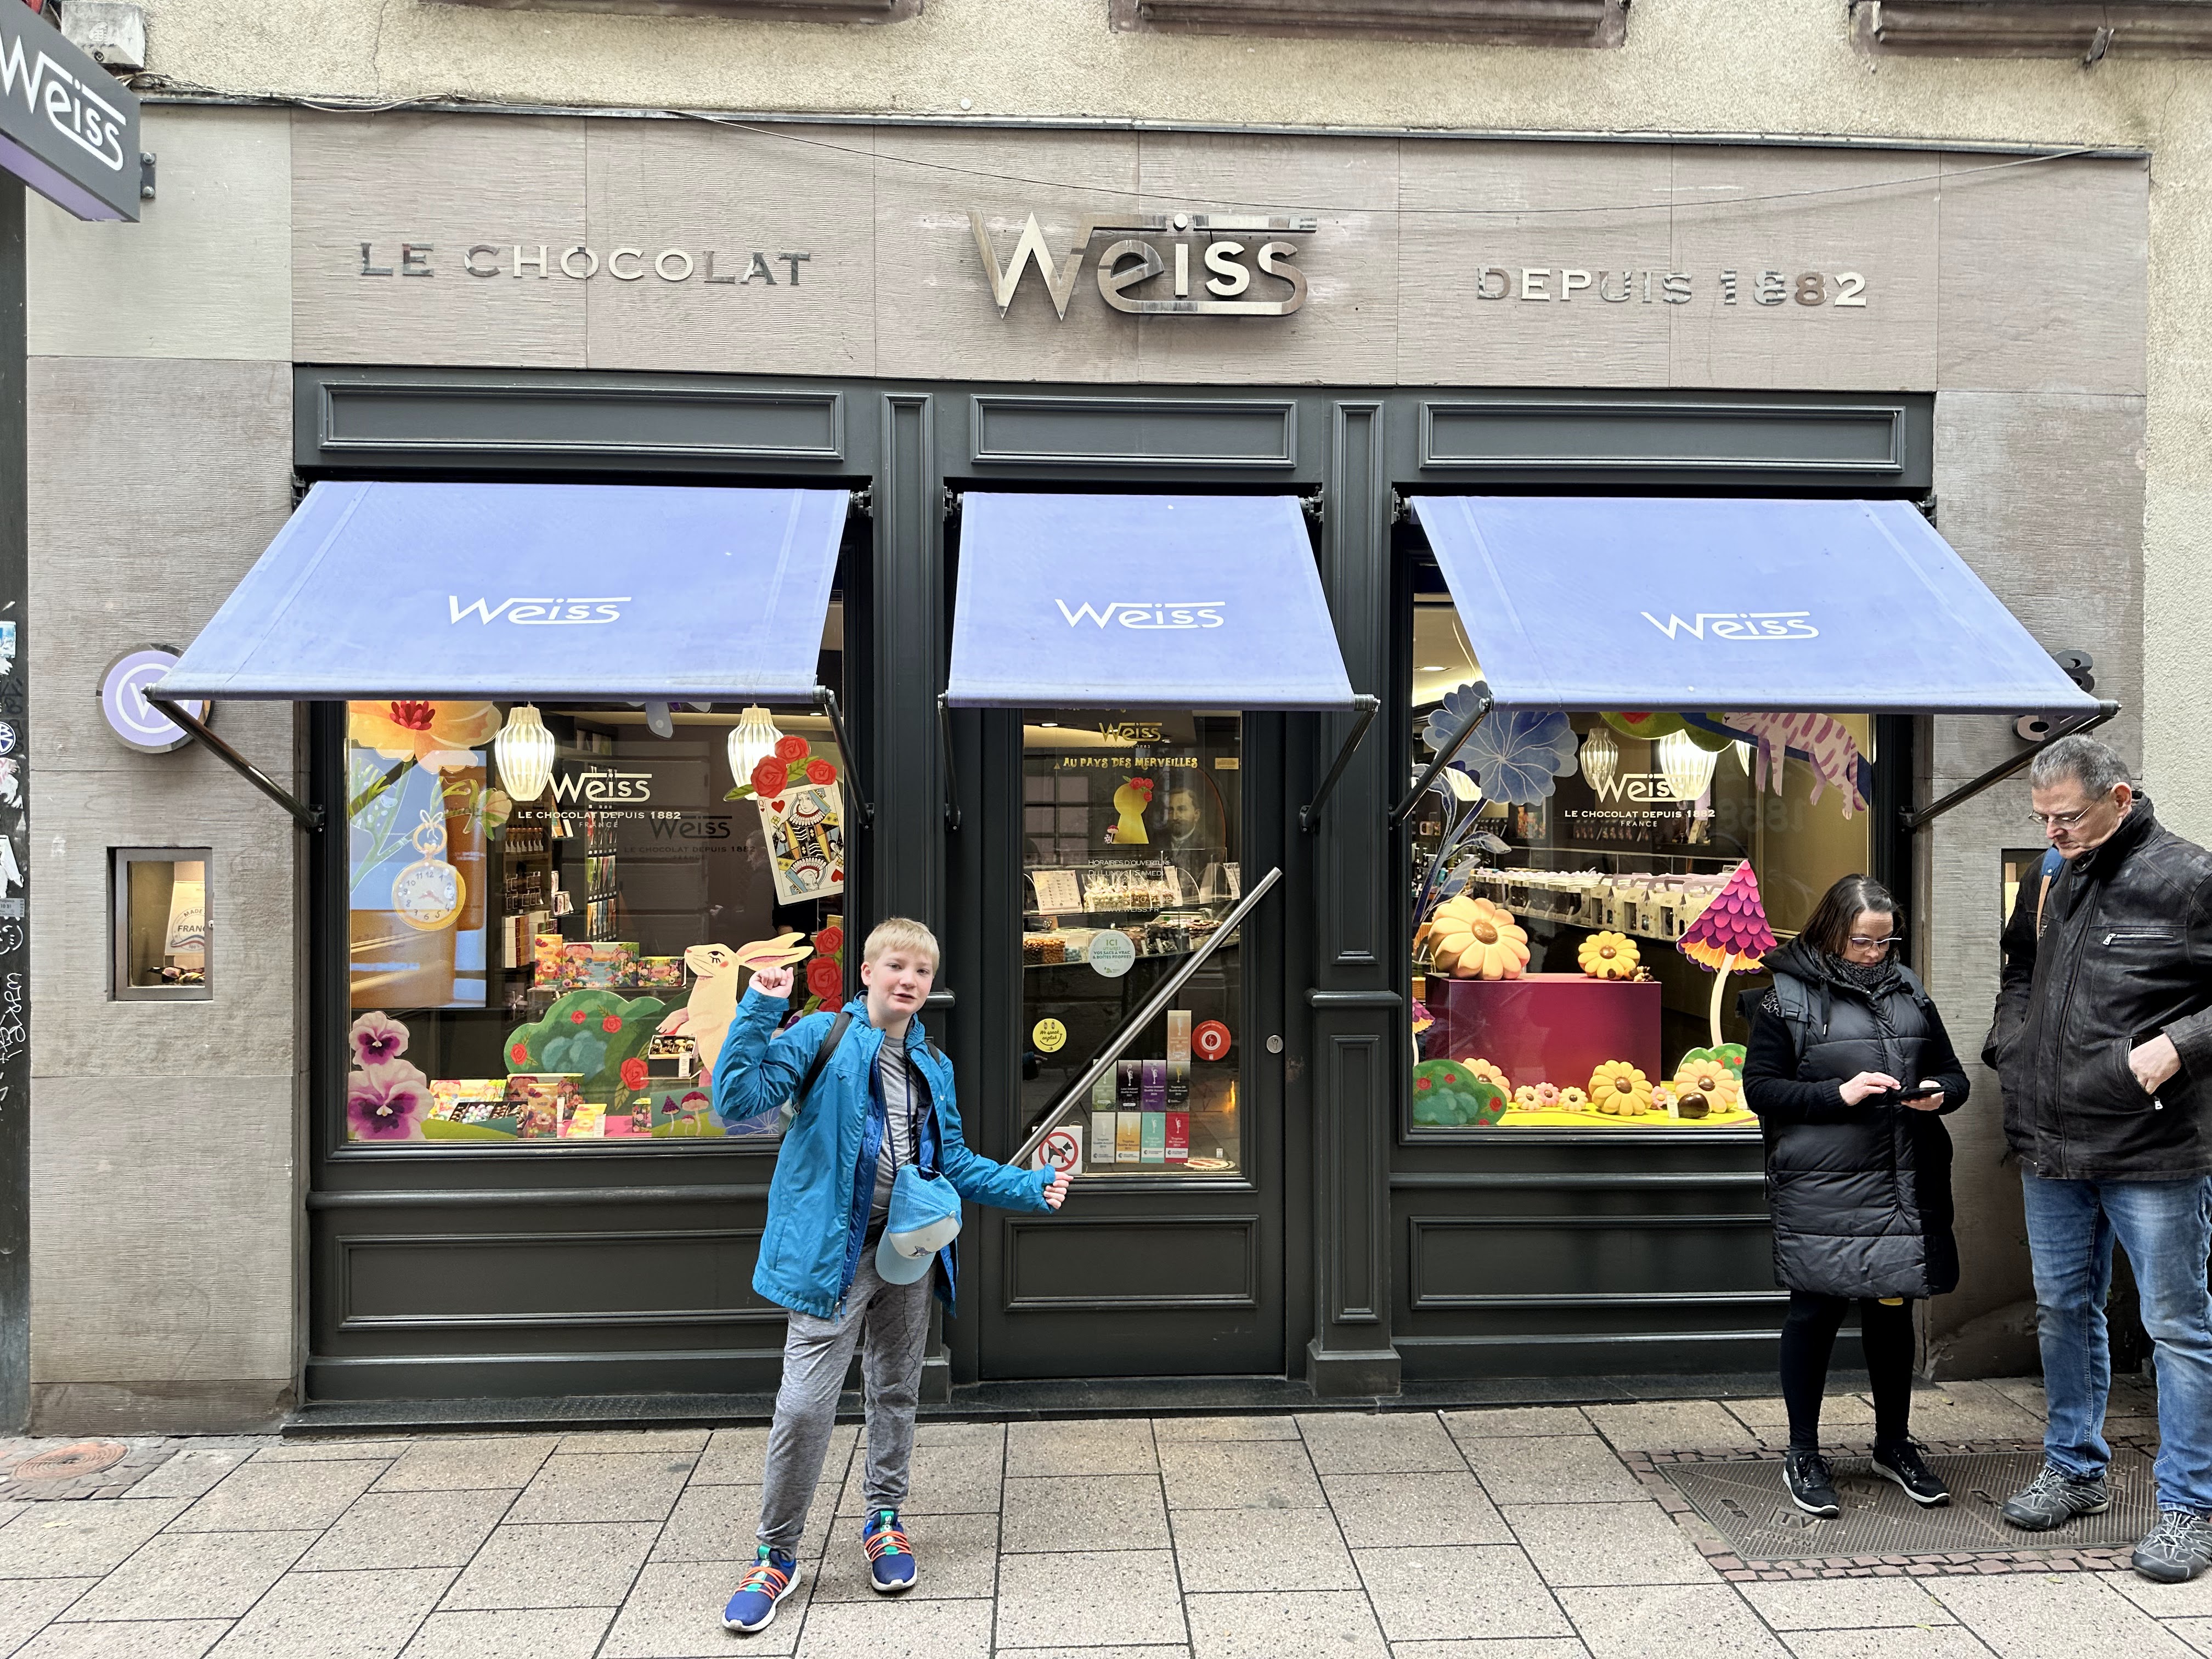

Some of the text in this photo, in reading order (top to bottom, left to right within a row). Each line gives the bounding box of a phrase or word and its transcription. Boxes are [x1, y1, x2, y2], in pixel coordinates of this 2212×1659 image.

[0, 27, 127, 171] Weiss
[360, 242, 811, 285] LE CHOCOLAT
[967, 211, 1317, 321] Weiss
[1477, 267, 1867, 307] DEPUIS 1882
[449, 595, 632, 625] Weiss
[1054, 599, 1226, 629] Weiss
[1640, 611, 1819, 641] Weiss
[1099, 722, 1163, 742] Weiss
[1063, 757, 1198, 770] AU PAYS DES MERVEILLES
[547, 772, 652, 803] Weiss
[1593, 773, 1688, 803] Weiss
[536, 811, 598, 819] CHOCOLAT
[603, 811, 645, 819] DEPUIS
[651, 811, 681, 819] 1882
[1686, 809, 1716, 817] 1882
[184, 909, 203, 917] MADE
[1779, 1510, 1819, 1528] TV
